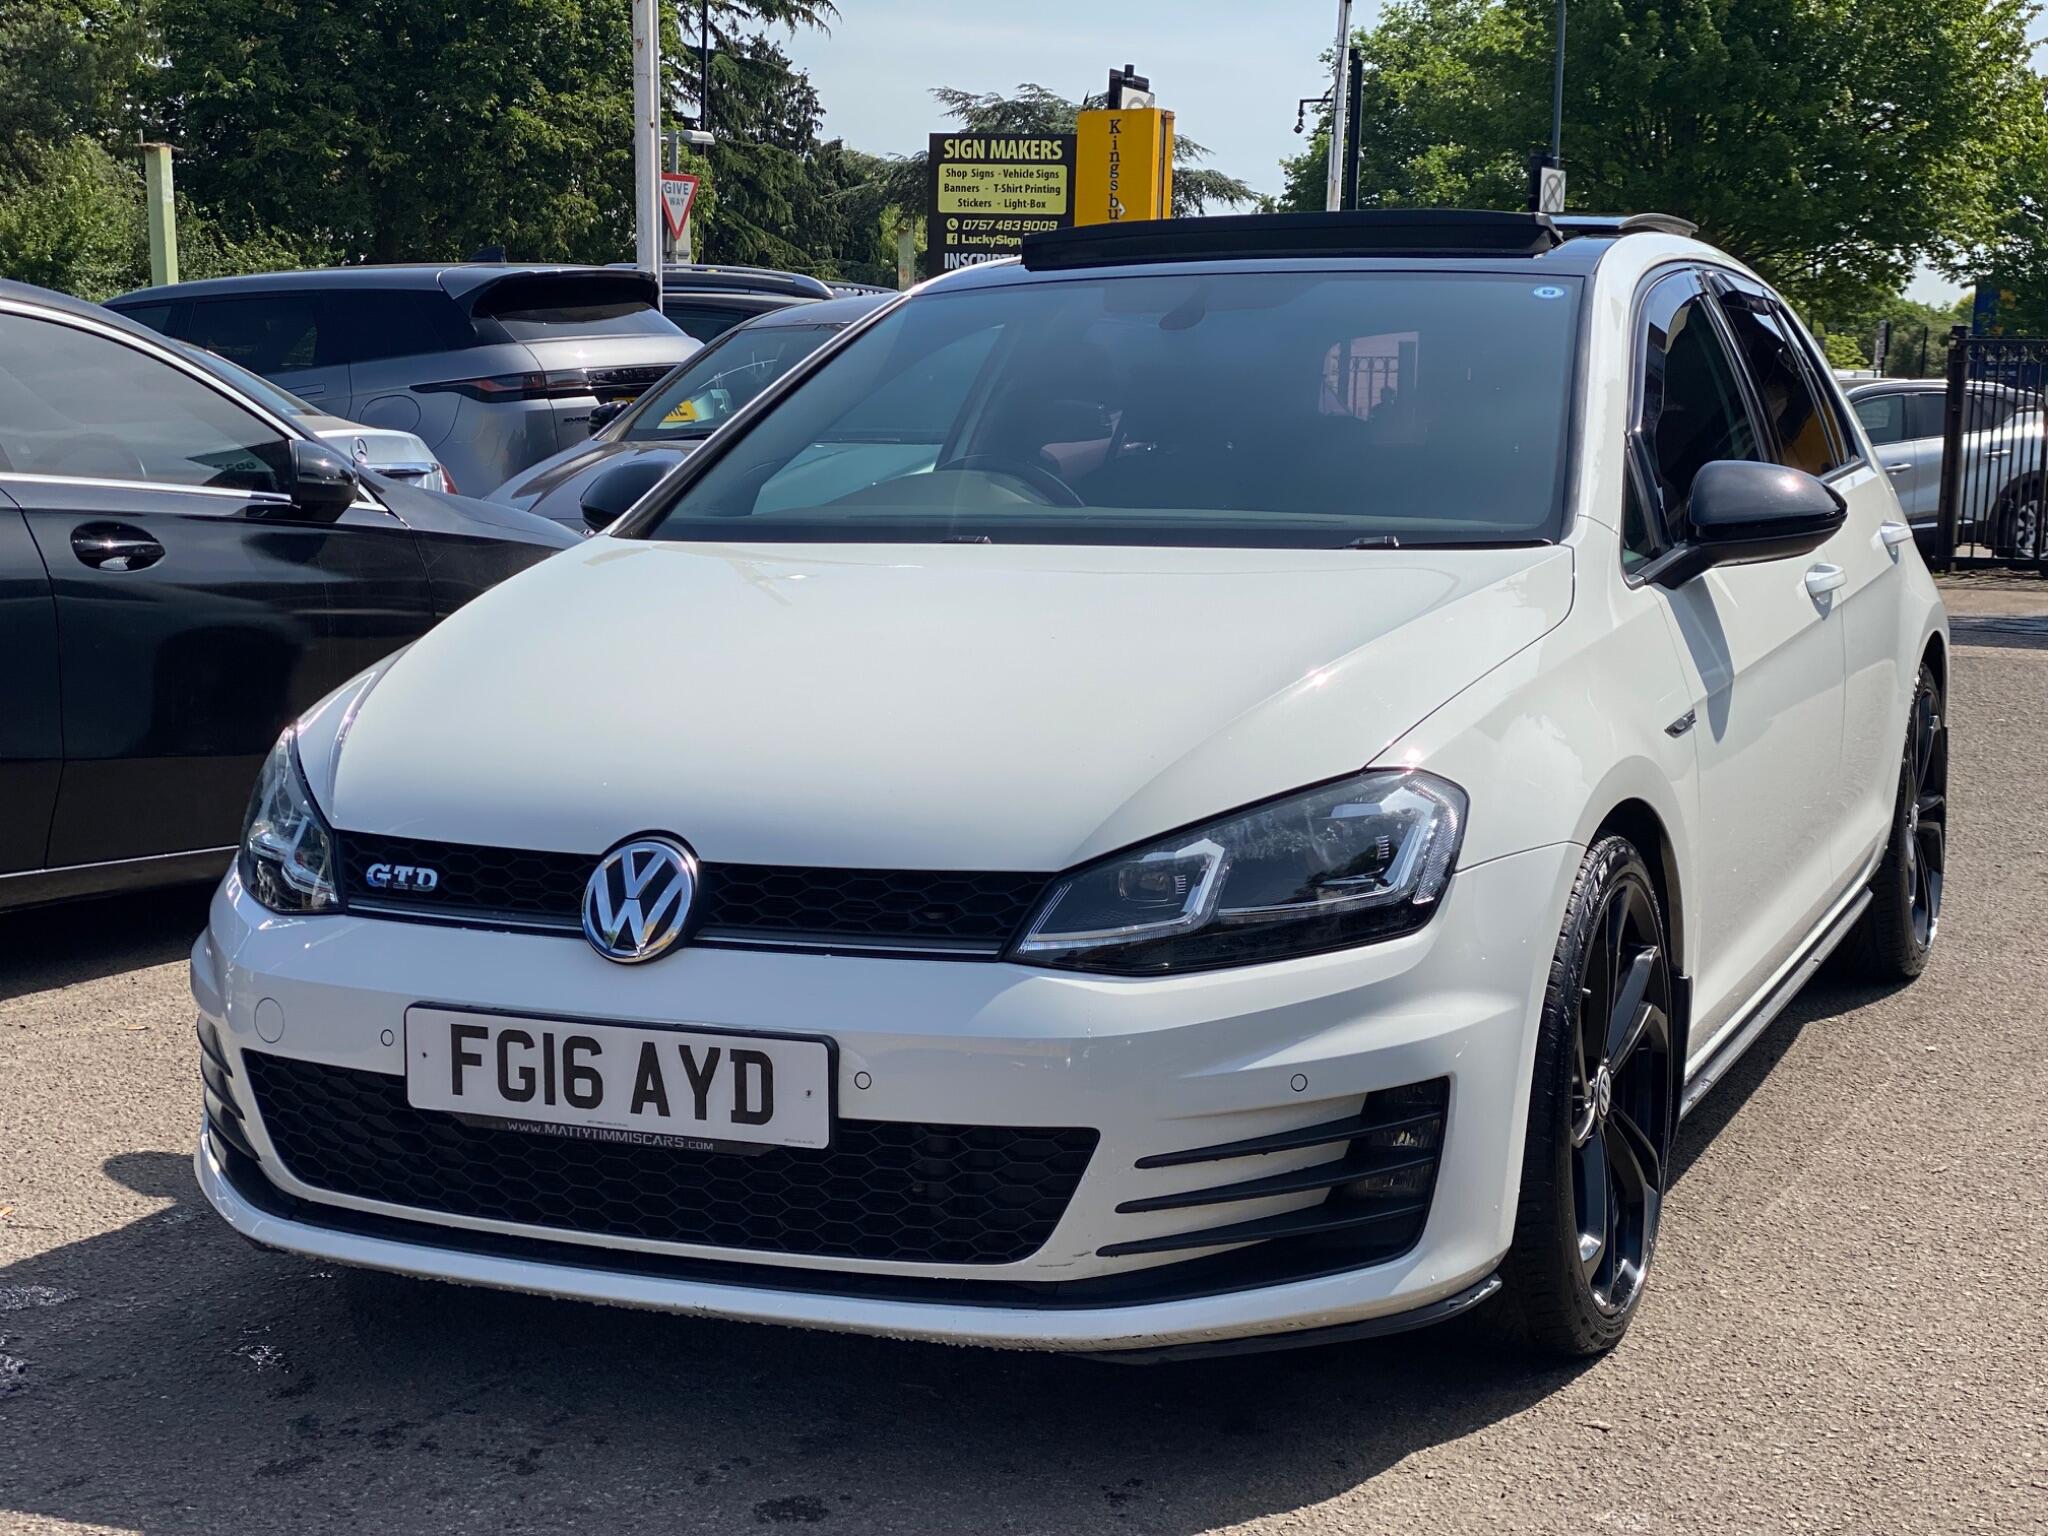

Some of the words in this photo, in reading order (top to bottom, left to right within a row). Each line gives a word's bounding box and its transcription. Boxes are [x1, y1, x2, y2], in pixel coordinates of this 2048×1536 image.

[943, 139, 985, 159] SIGN
[990, 139, 1063, 160] MAKERS
[945, 168, 968, 179] Shop
[971, 168, 995, 180] Signs
[1003, 169, 1034, 179] Vehicle
[1036, 169, 1060, 180] Signs
[1108, 119, 1122, 221] Kingsbu
[664, 181, 690, 195] GIVE
[944, 183, 980, 192] Banners
[993, 183, 1023, 193] T-Shirt
[1024, 184, 1061, 195] Printing
[669, 197, 685, 206] WAY
[957, 198, 992, 208] Stickers
[1004, 198, 1047, 210] Light-Box
[961, 234, 1022, 248] LuckySign
[366, 863, 438, 892] GTD
[450, 1023, 604, 1109] FG16
[630, 1041, 774, 1126] AYD
